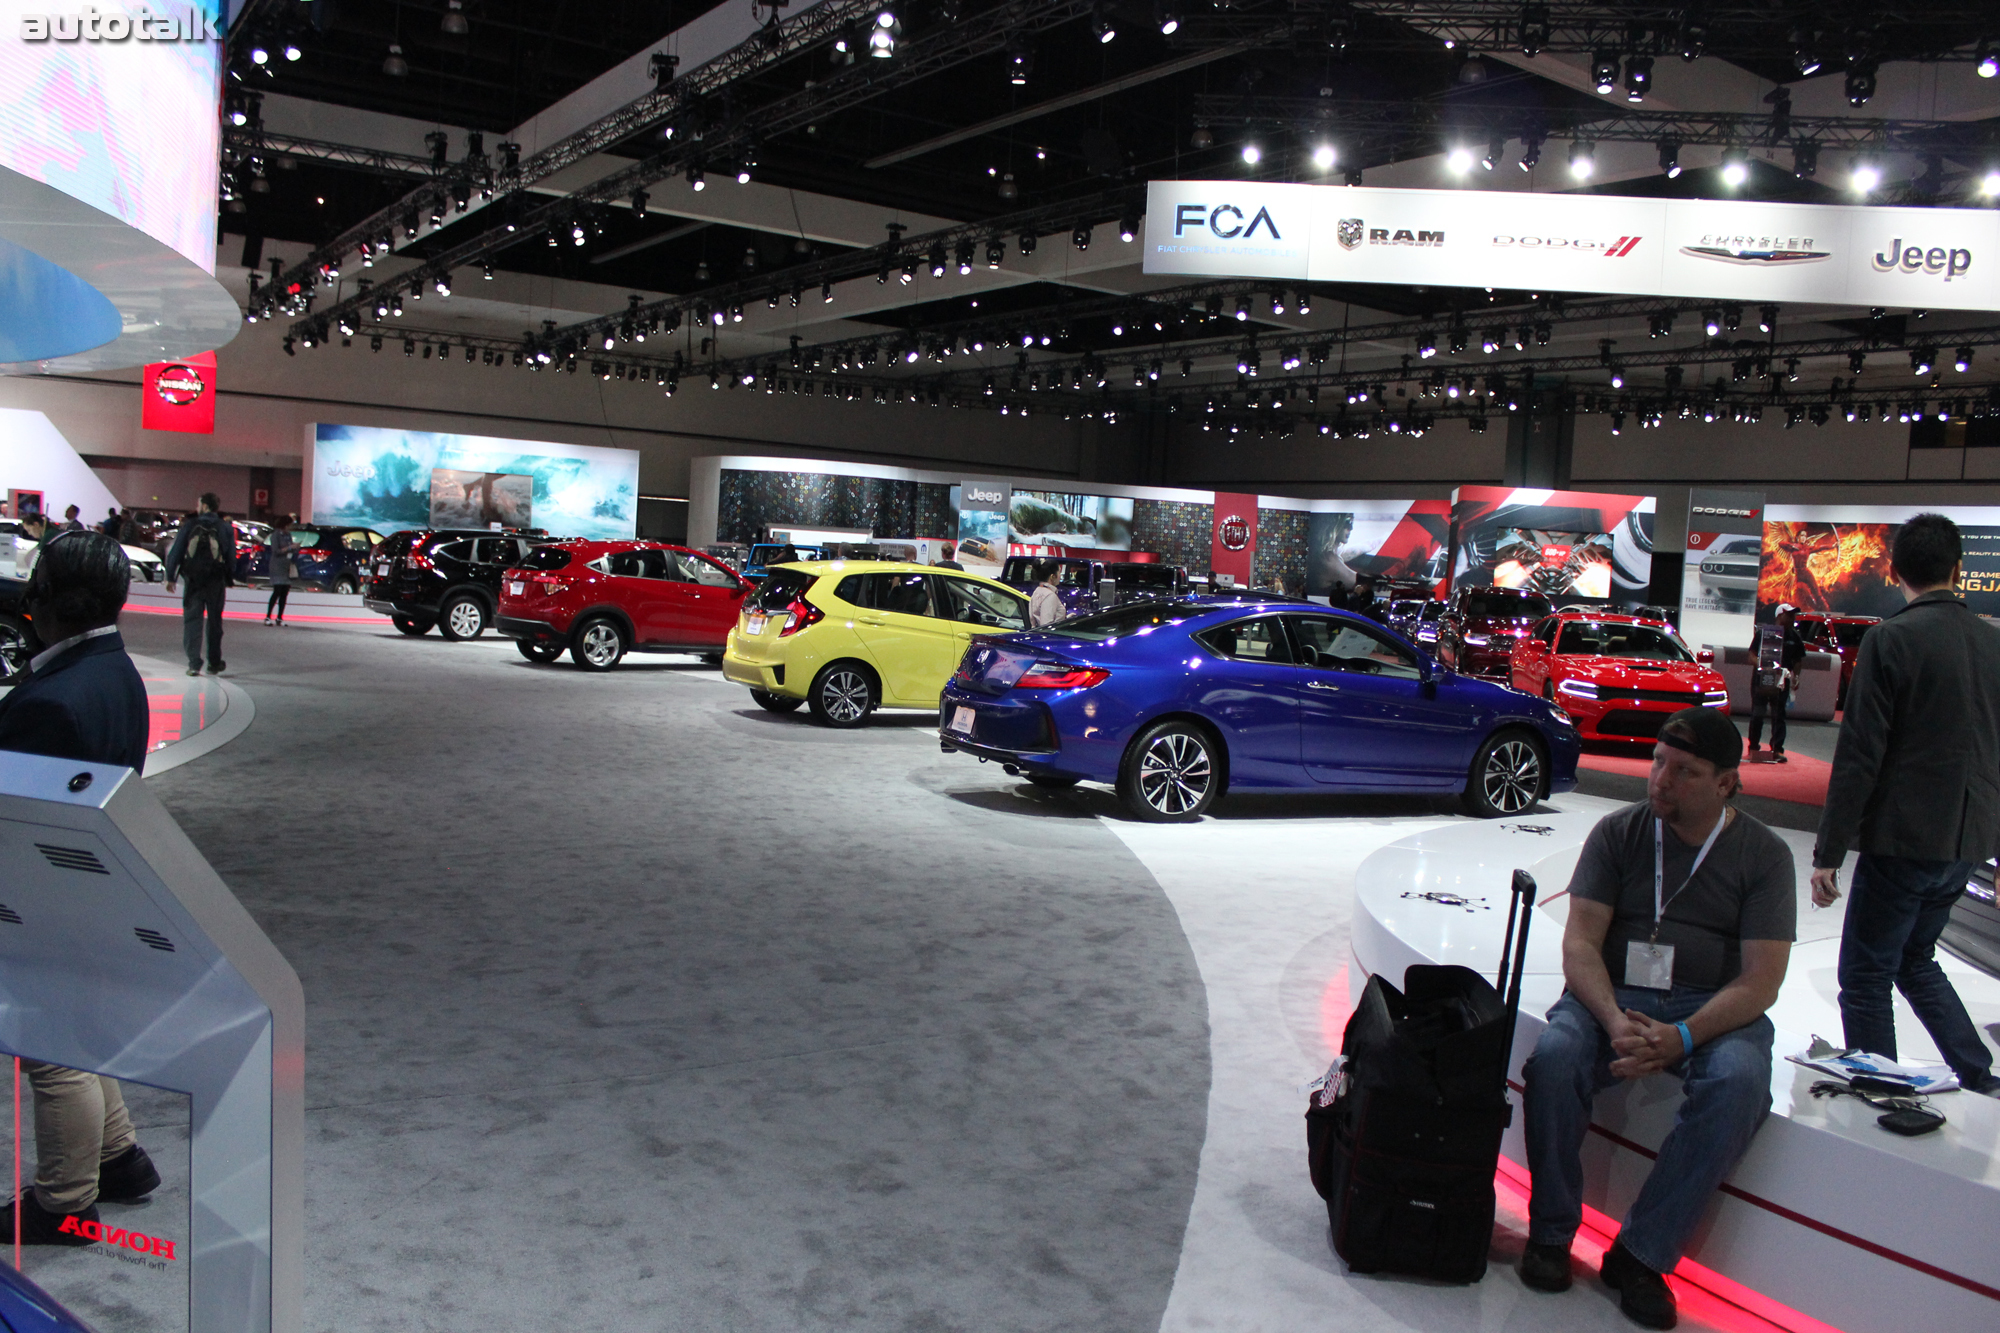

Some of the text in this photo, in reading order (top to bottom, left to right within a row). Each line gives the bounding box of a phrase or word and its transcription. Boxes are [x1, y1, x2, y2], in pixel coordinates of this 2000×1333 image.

[1174, 202, 1282, 240] FCA
[1369, 228, 1445, 246] RAM
[1700, 234, 1814, 250] CHRYSLER
[1157, 244, 1177, 253] FIAT
[1179, 245, 1228, 255] CHRYSLER
[1875, 238, 1972, 281] Jeep
[159, 379, 202, 391] NISSAN
[326, 460, 376, 482] Jeep
[967, 488, 1003, 505] Jeep
[989, 512, 1006, 521] Jeep
[1692, 507, 1752, 517] DODGE
